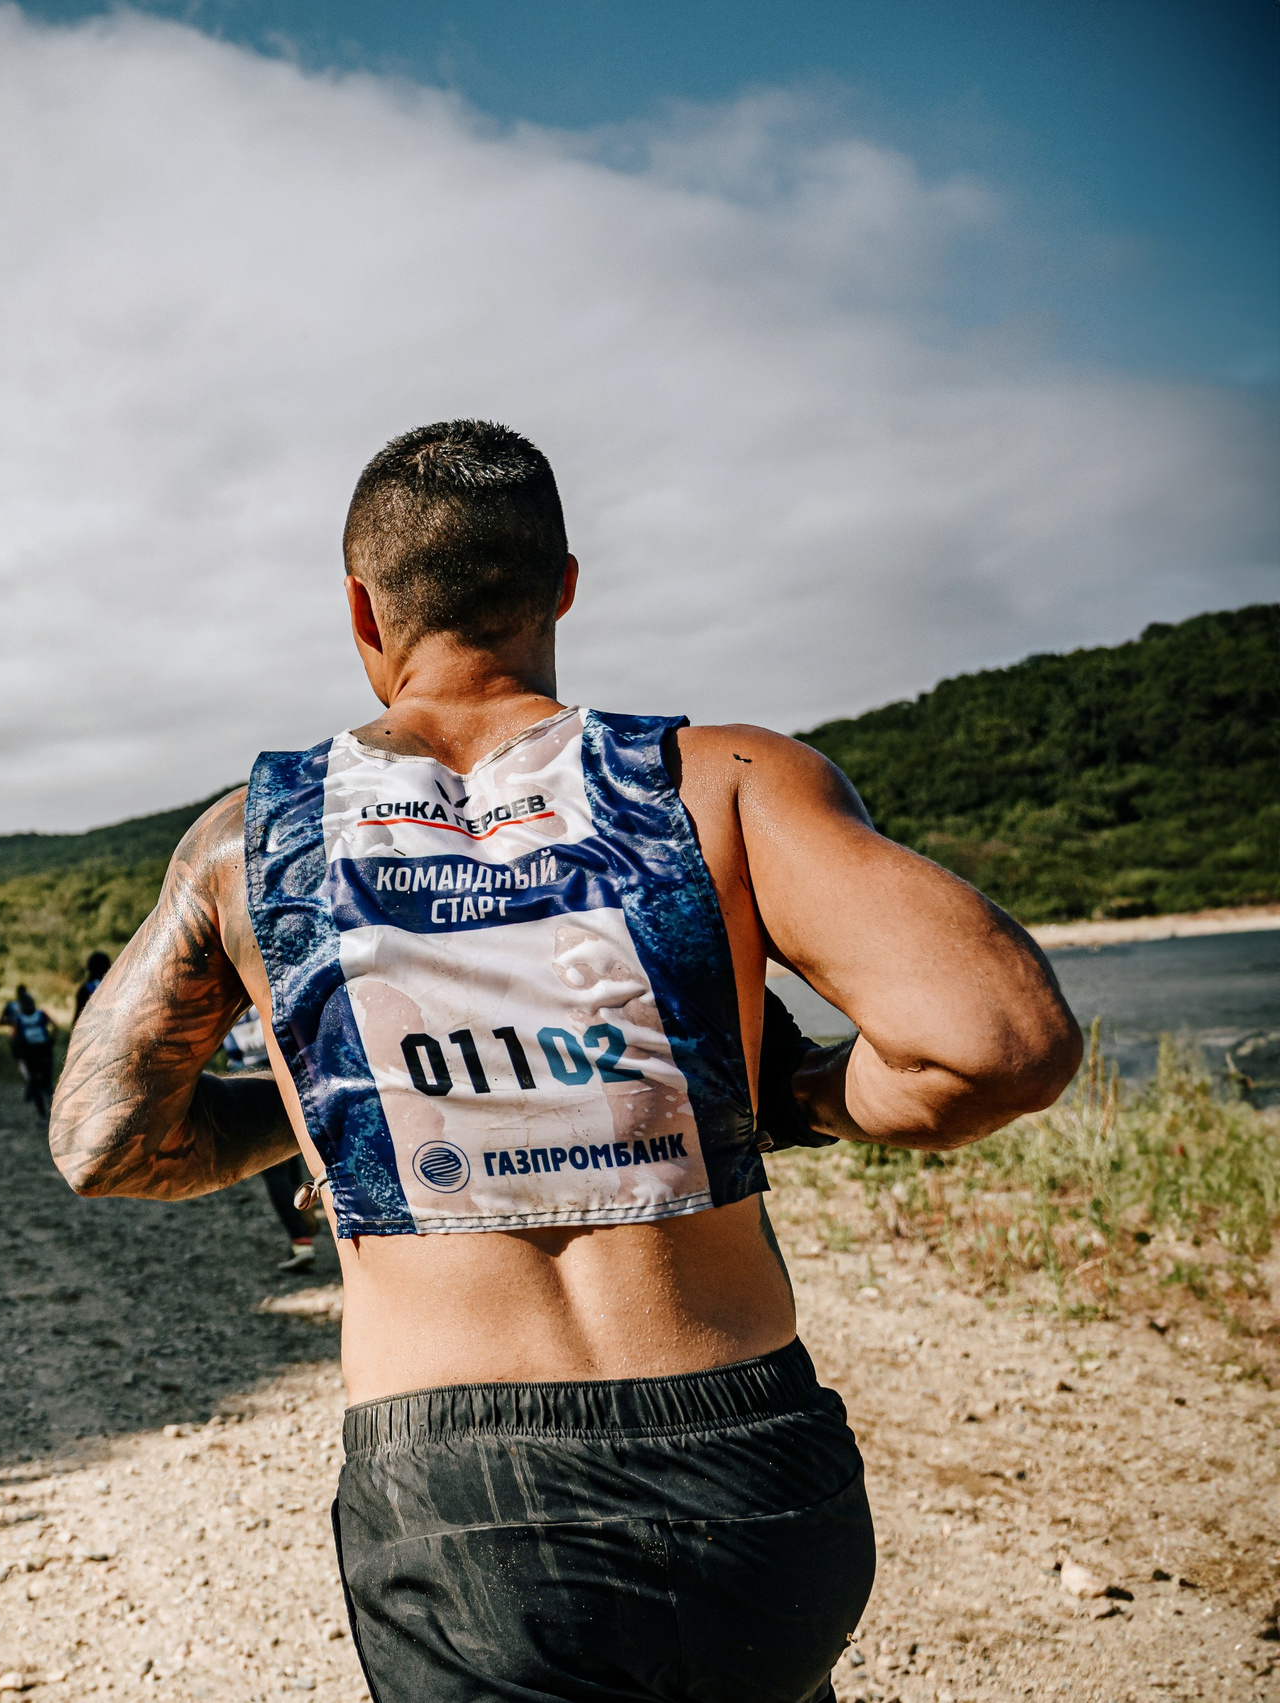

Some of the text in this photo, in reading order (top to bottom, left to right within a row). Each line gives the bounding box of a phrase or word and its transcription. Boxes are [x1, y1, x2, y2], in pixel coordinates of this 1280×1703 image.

[361, 794, 547, 834] ГОНКА ГЕРОЕВ
[376, 848, 557, 893] КОМАНДНЫЙ
[430, 896, 512, 924] СТАРТ
[400, 1023, 645, 1097] 01102
[483, 1132, 689, 1177] ГАЗПРОМБАНК
